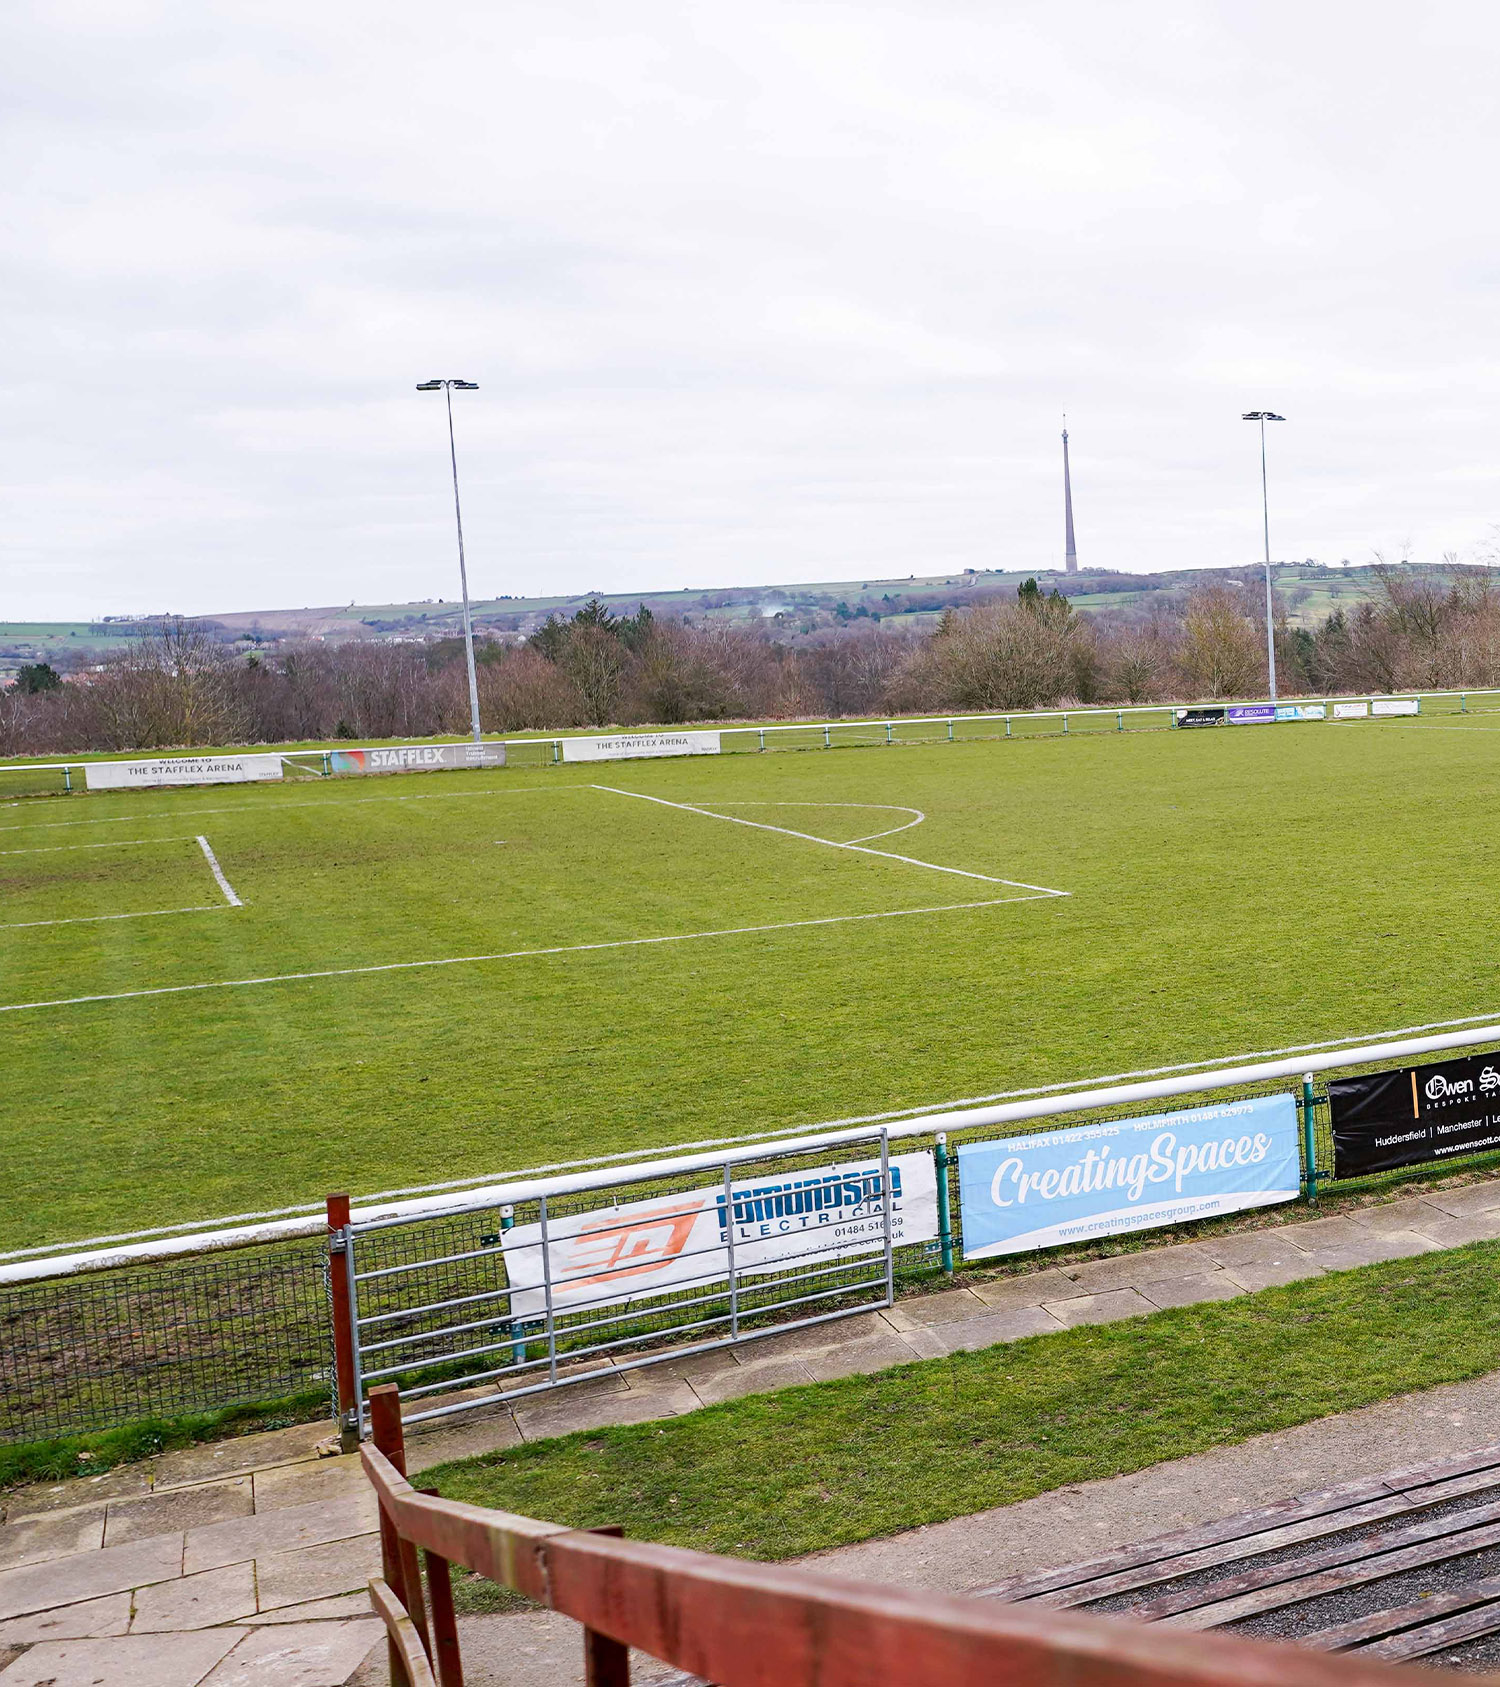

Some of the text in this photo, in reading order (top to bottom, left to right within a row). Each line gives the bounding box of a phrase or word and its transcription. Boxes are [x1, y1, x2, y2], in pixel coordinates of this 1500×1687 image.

[596, 738, 688, 750] THE STAFFLEX ARENA
[370, 748, 445, 767] STAFFLEX
[128, 763, 242, 776] THE STAFFLEX ARENA
[1425, 1074, 1473, 1100] Owen
[1426, 1095, 1477, 1110] BESPOKE
[1008, 1137, 1050, 1153] HALIFAX
[1133, 1116, 1188, 1132] HOLMFIRTH
[1190, 1110, 1219, 1124] 01484
[1375, 1129, 1426, 1148] Huddersfield
[1437, 1118, 1482, 1136] Manchester
[720, 1202, 902, 1242] ELECTRICAL
[834, 1217, 904, 1238] 01484 51659
[1058, 1200, 1220, 1238] www.creatingspacesgroup.com
